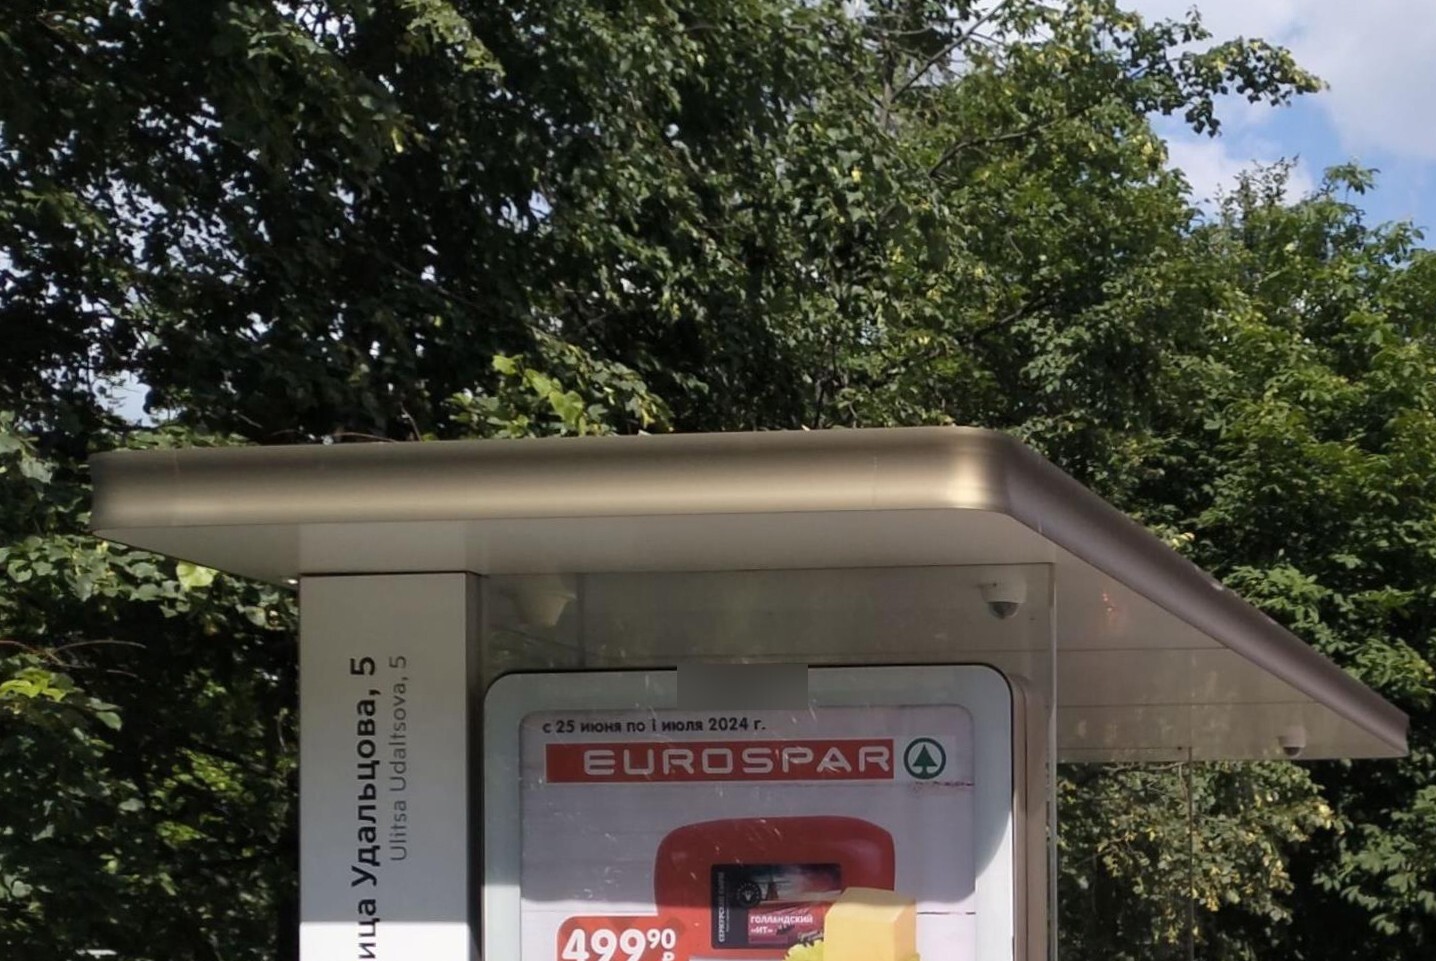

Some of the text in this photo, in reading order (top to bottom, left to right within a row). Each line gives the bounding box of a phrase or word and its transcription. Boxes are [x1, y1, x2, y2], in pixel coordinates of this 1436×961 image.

[350, 656, 376, 676] 5
[542, 722, 551, 733] с
[556, 720, 575, 733] 25
[581, 720, 622, 733] июня
[627, 721, 645, 732] по
[662, 719, 703, 732] июля
[708, 717, 749, 731] 2024
[753, 719, 767, 731] г.
[389, 656, 408, 861] Ulitsa Udaltsova, 5
[583, 746, 890, 775] EUROSPAR
[351, 689, 381, 887] Удальцова,
